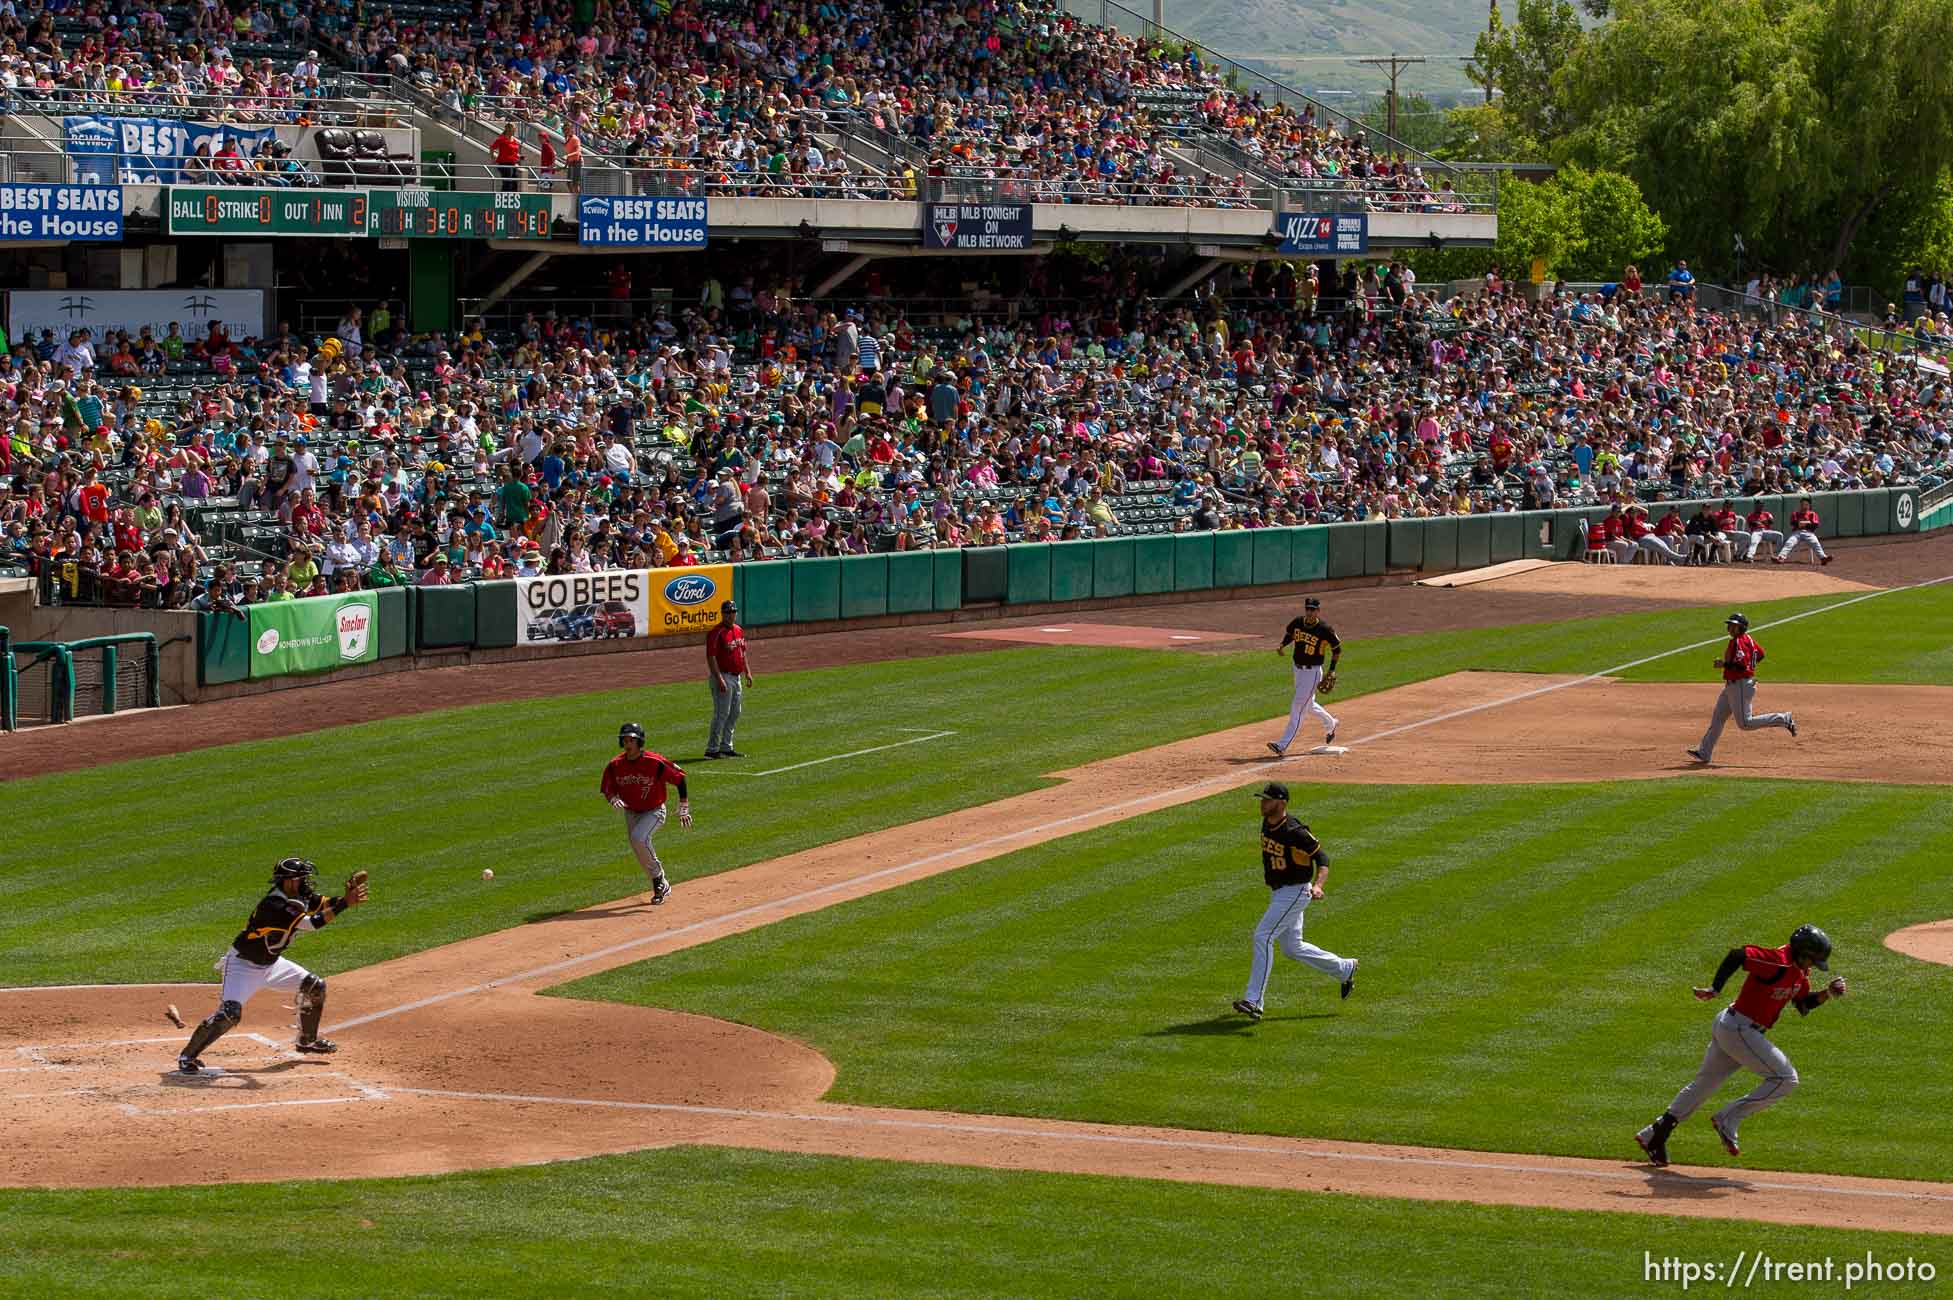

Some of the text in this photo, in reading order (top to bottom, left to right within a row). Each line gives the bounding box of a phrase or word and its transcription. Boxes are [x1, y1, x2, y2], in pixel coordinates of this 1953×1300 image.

[122, 123, 189, 156] BEST
[0, 187, 119, 211] BEST SEATS
[396, 191, 430, 208] VISITORS
[494, 193, 521, 209] BEES
[173, 201, 203, 218] BALL
[206, 195, 217, 223] 0
[218, 202, 259, 219] STRIKE
[259, 196, 271, 223] 0
[284, 203, 309, 220] OUT
[323, 204, 343, 220] INN
[353, 198, 365, 225] 2
[613, 200, 705, 220] BEST SEATS
[935, 208, 957, 219] MLB
[961, 206, 1023, 220] MLB TONIGHT
[0, 212, 118, 236] he House
[371, 212, 379, 229] R
[405, 213, 413, 229] H
[426, 208, 437, 234] 3
[439, 212, 446, 230] E
[447, 207, 459, 234] 0
[464, 209, 548, 236] R 4 H 4 E 0
[985, 221, 999, 234] ON
[583, 221, 704, 241] in the House
[1286, 217, 1320, 245] KJZZ
[958, 235, 1024, 248] MLB NETWORK
[1898, 500, 1911, 519] 42
[527, 574, 639, 608] GO BEES
[674, 580, 705, 600] Ford
[340, 614, 366, 632] Sinclair
[664, 608, 717, 625] Go Further
[1294, 628, 1319, 646] BEES
